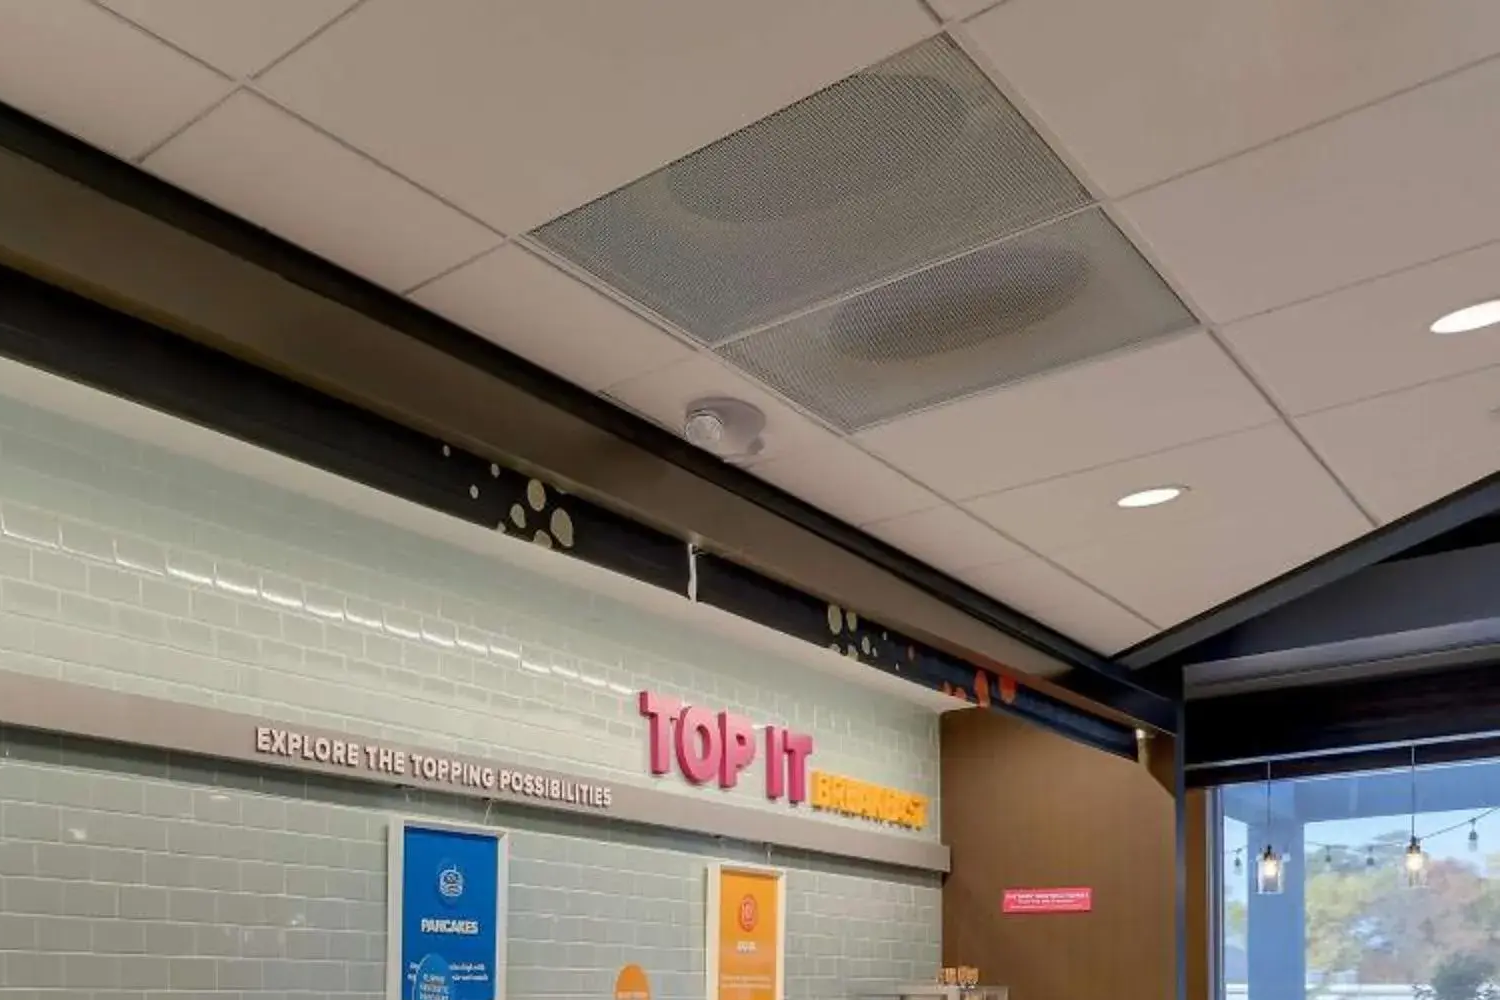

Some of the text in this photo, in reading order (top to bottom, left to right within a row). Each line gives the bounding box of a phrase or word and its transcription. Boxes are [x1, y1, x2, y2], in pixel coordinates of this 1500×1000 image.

[255, 726, 613, 807] EXPLORE THE TOPPING POSSIBILITIES
[639, 690, 813, 806] TOP IT
[420, 918, 479, 935] PANCAKES
